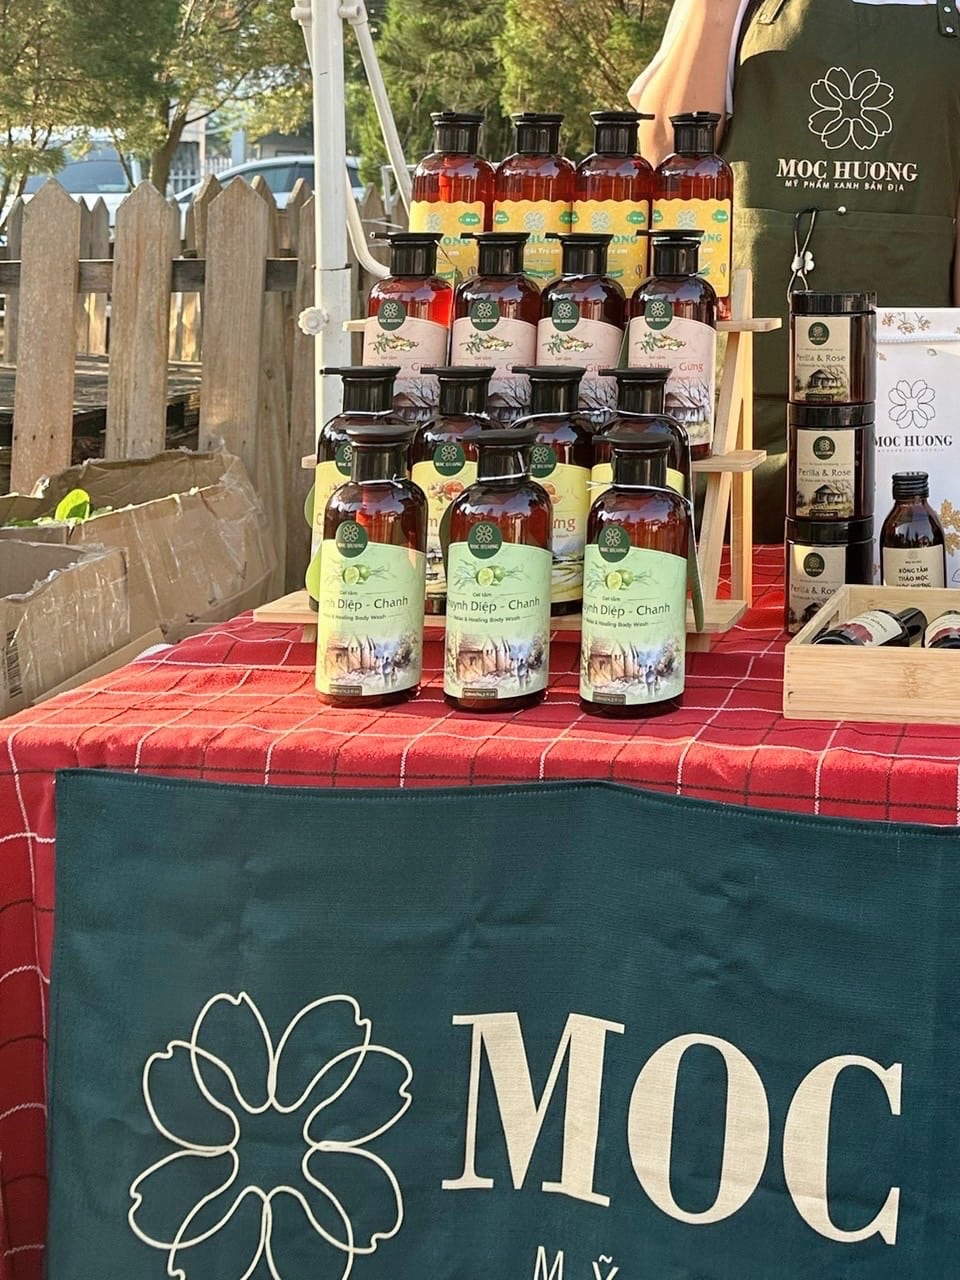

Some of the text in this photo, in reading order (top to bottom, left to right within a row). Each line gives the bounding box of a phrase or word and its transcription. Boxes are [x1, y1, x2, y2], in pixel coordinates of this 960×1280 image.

[776, 158, 918, 182] MOC HUONG
[833, 181, 859, 190] XANH
[875, 435, 953, 447] MOC HUONG
[338, 596, 408, 612] Diệp Chanh
[471, 601, 497, 614] Diệp
[508, 597, 540, 610] Chanh
[600, 603, 670, 618] Diệp Chanh
[442, 1012, 902, 1246] MOC
